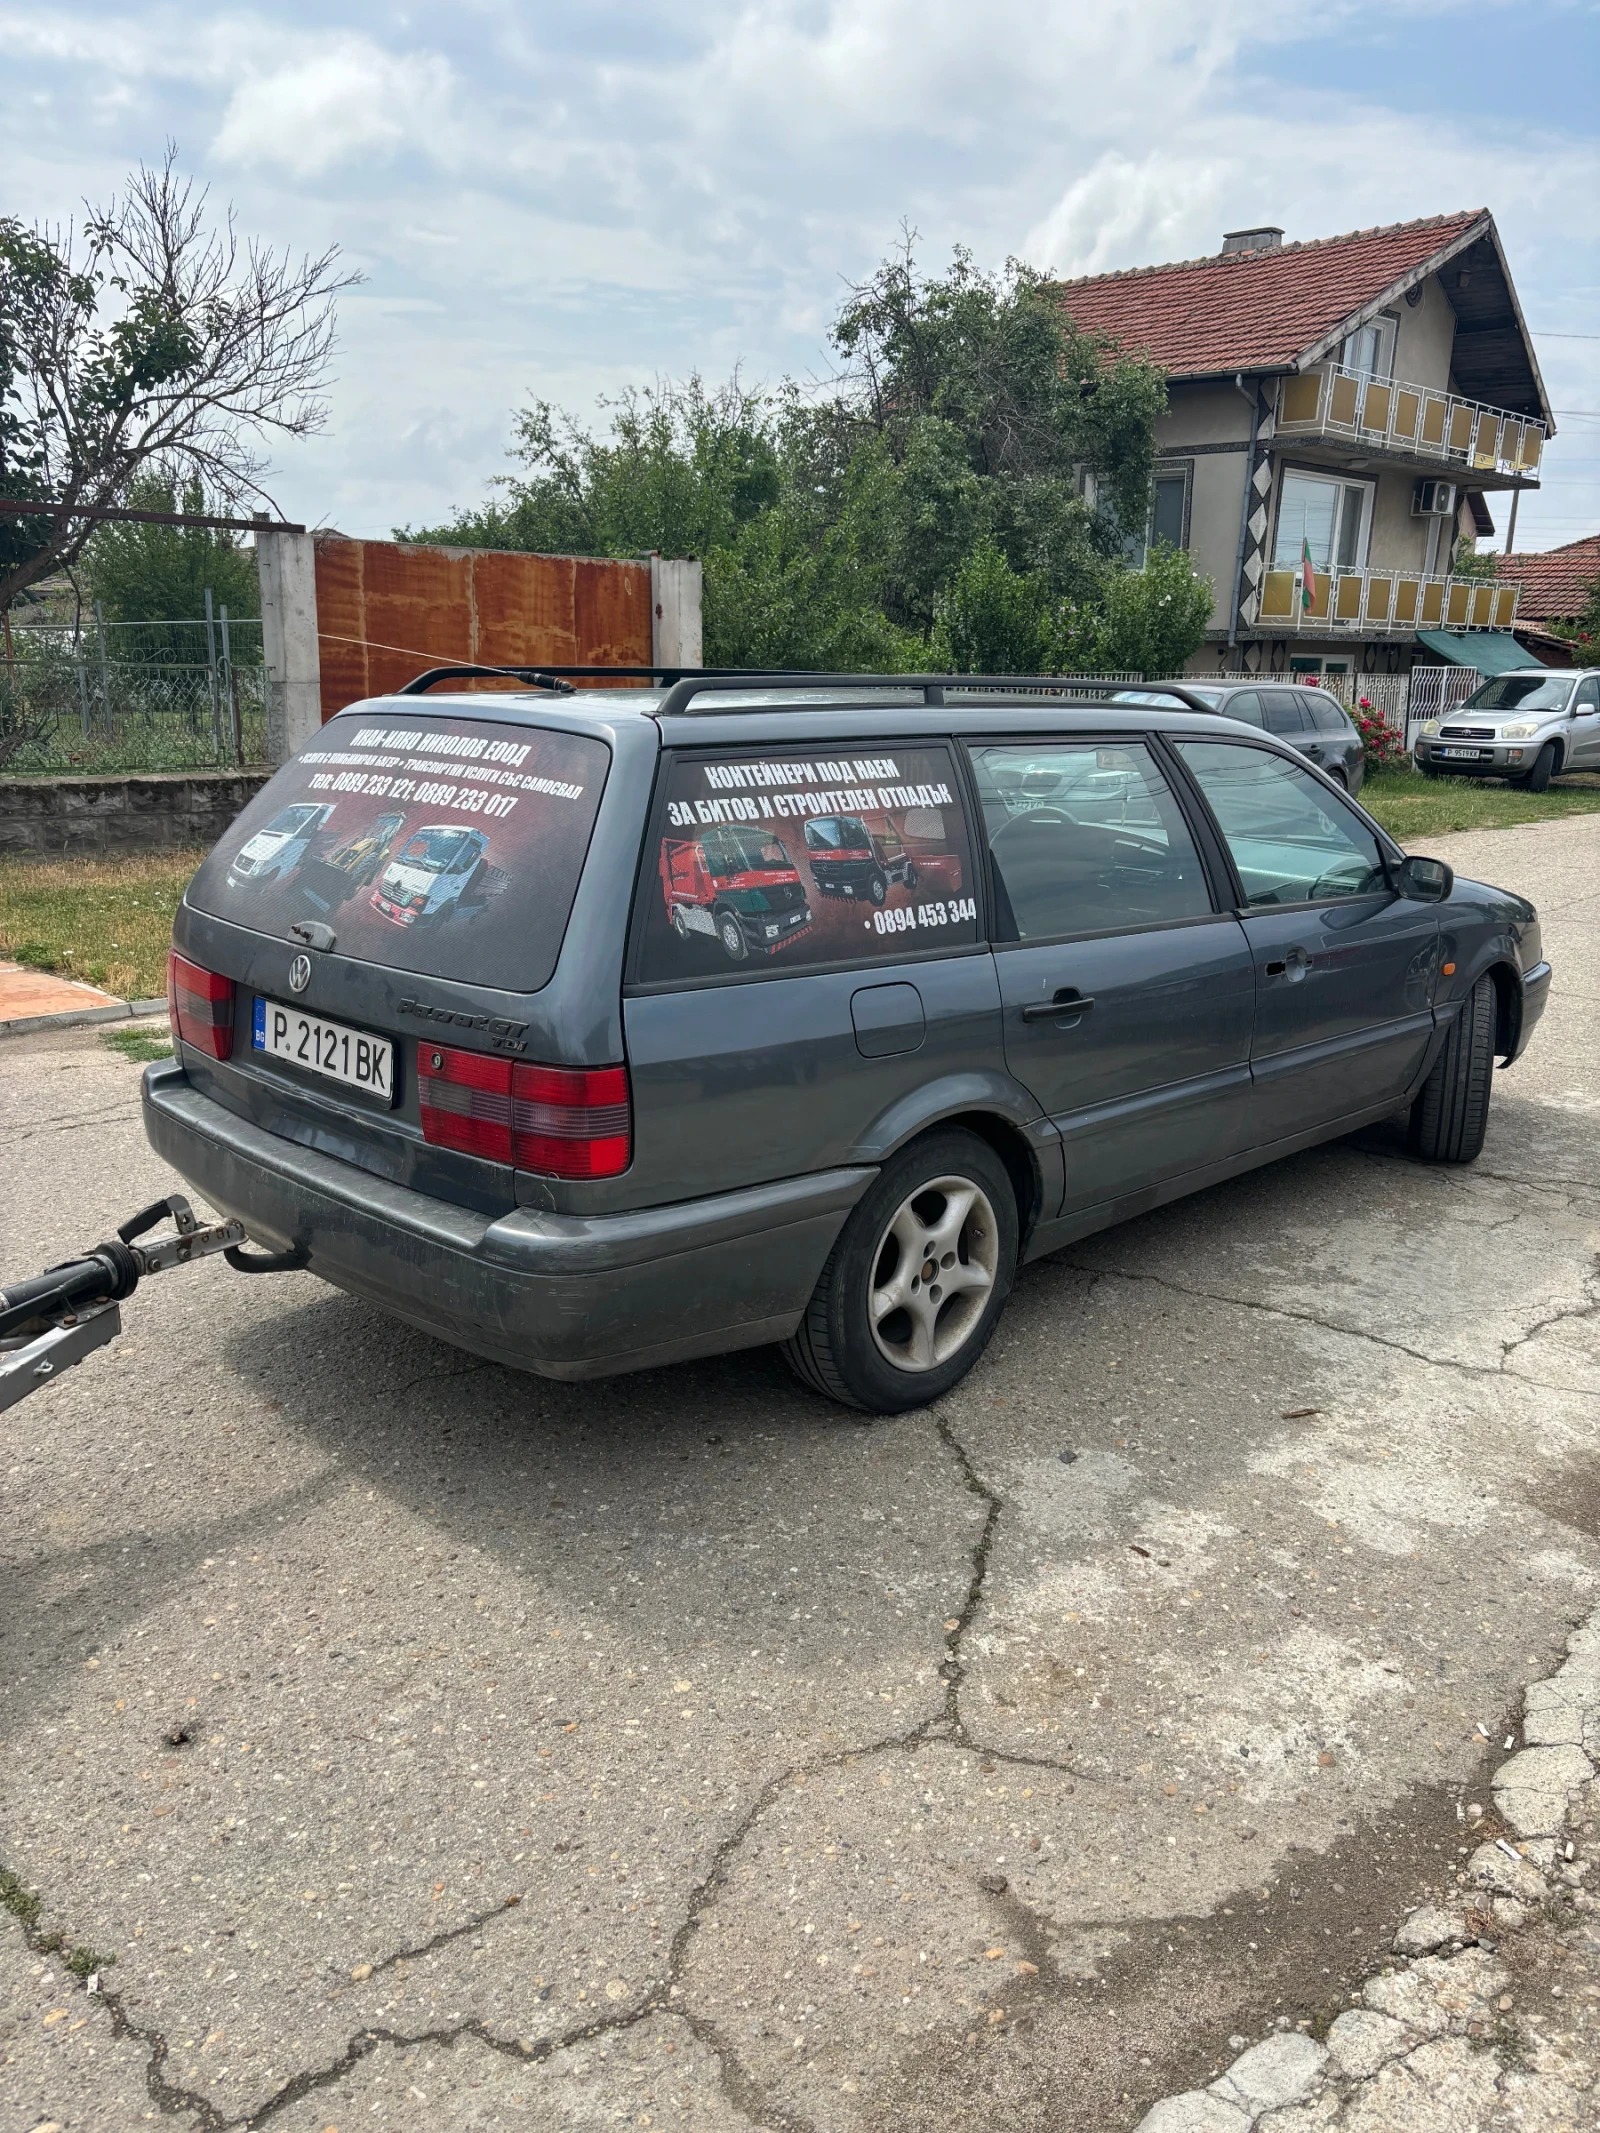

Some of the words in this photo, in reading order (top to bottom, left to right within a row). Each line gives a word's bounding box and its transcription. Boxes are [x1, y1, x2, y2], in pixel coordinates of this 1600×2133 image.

[415, 733, 488, 758] НИКОЛОВ
[482, 740, 532, 767] ЕООД
[374, 755, 400, 768] БАГЕР
[403, 758, 466, 777] ТРАНСПОРТНИ
[462, 765, 501, 783] УСЛУГИ
[497, 771, 524, 788] СЪС
[520, 775, 584, 800] САМОСВАЛ
[703, 760, 818, 789] КОНТЕЙНЕРИ
[815, 761, 858, 784] ПОД
[852, 759, 901, 780] НАЕМ
[331, 772, 368, 793] 0889
[361, 774, 393, 796] 233
[413, 781, 457, 806] 0889
[451, 788, 488, 812] 233
[483, 793, 518, 818] 017
[667, 801, 697, 827] ЗА
[694, 797, 760, 825] БИТОВ
[757, 795, 774, 819] И
[772, 788, 879, 818] СТРОИТЕЛЕН
[877, 783, 953, 809] ОТПАДЪК
[873, 906, 916, 935] 0894
[918, 902, 948, 928] 453
[947, 898, 977, 923] 344
[255, 1029, 265, 1043] BG
